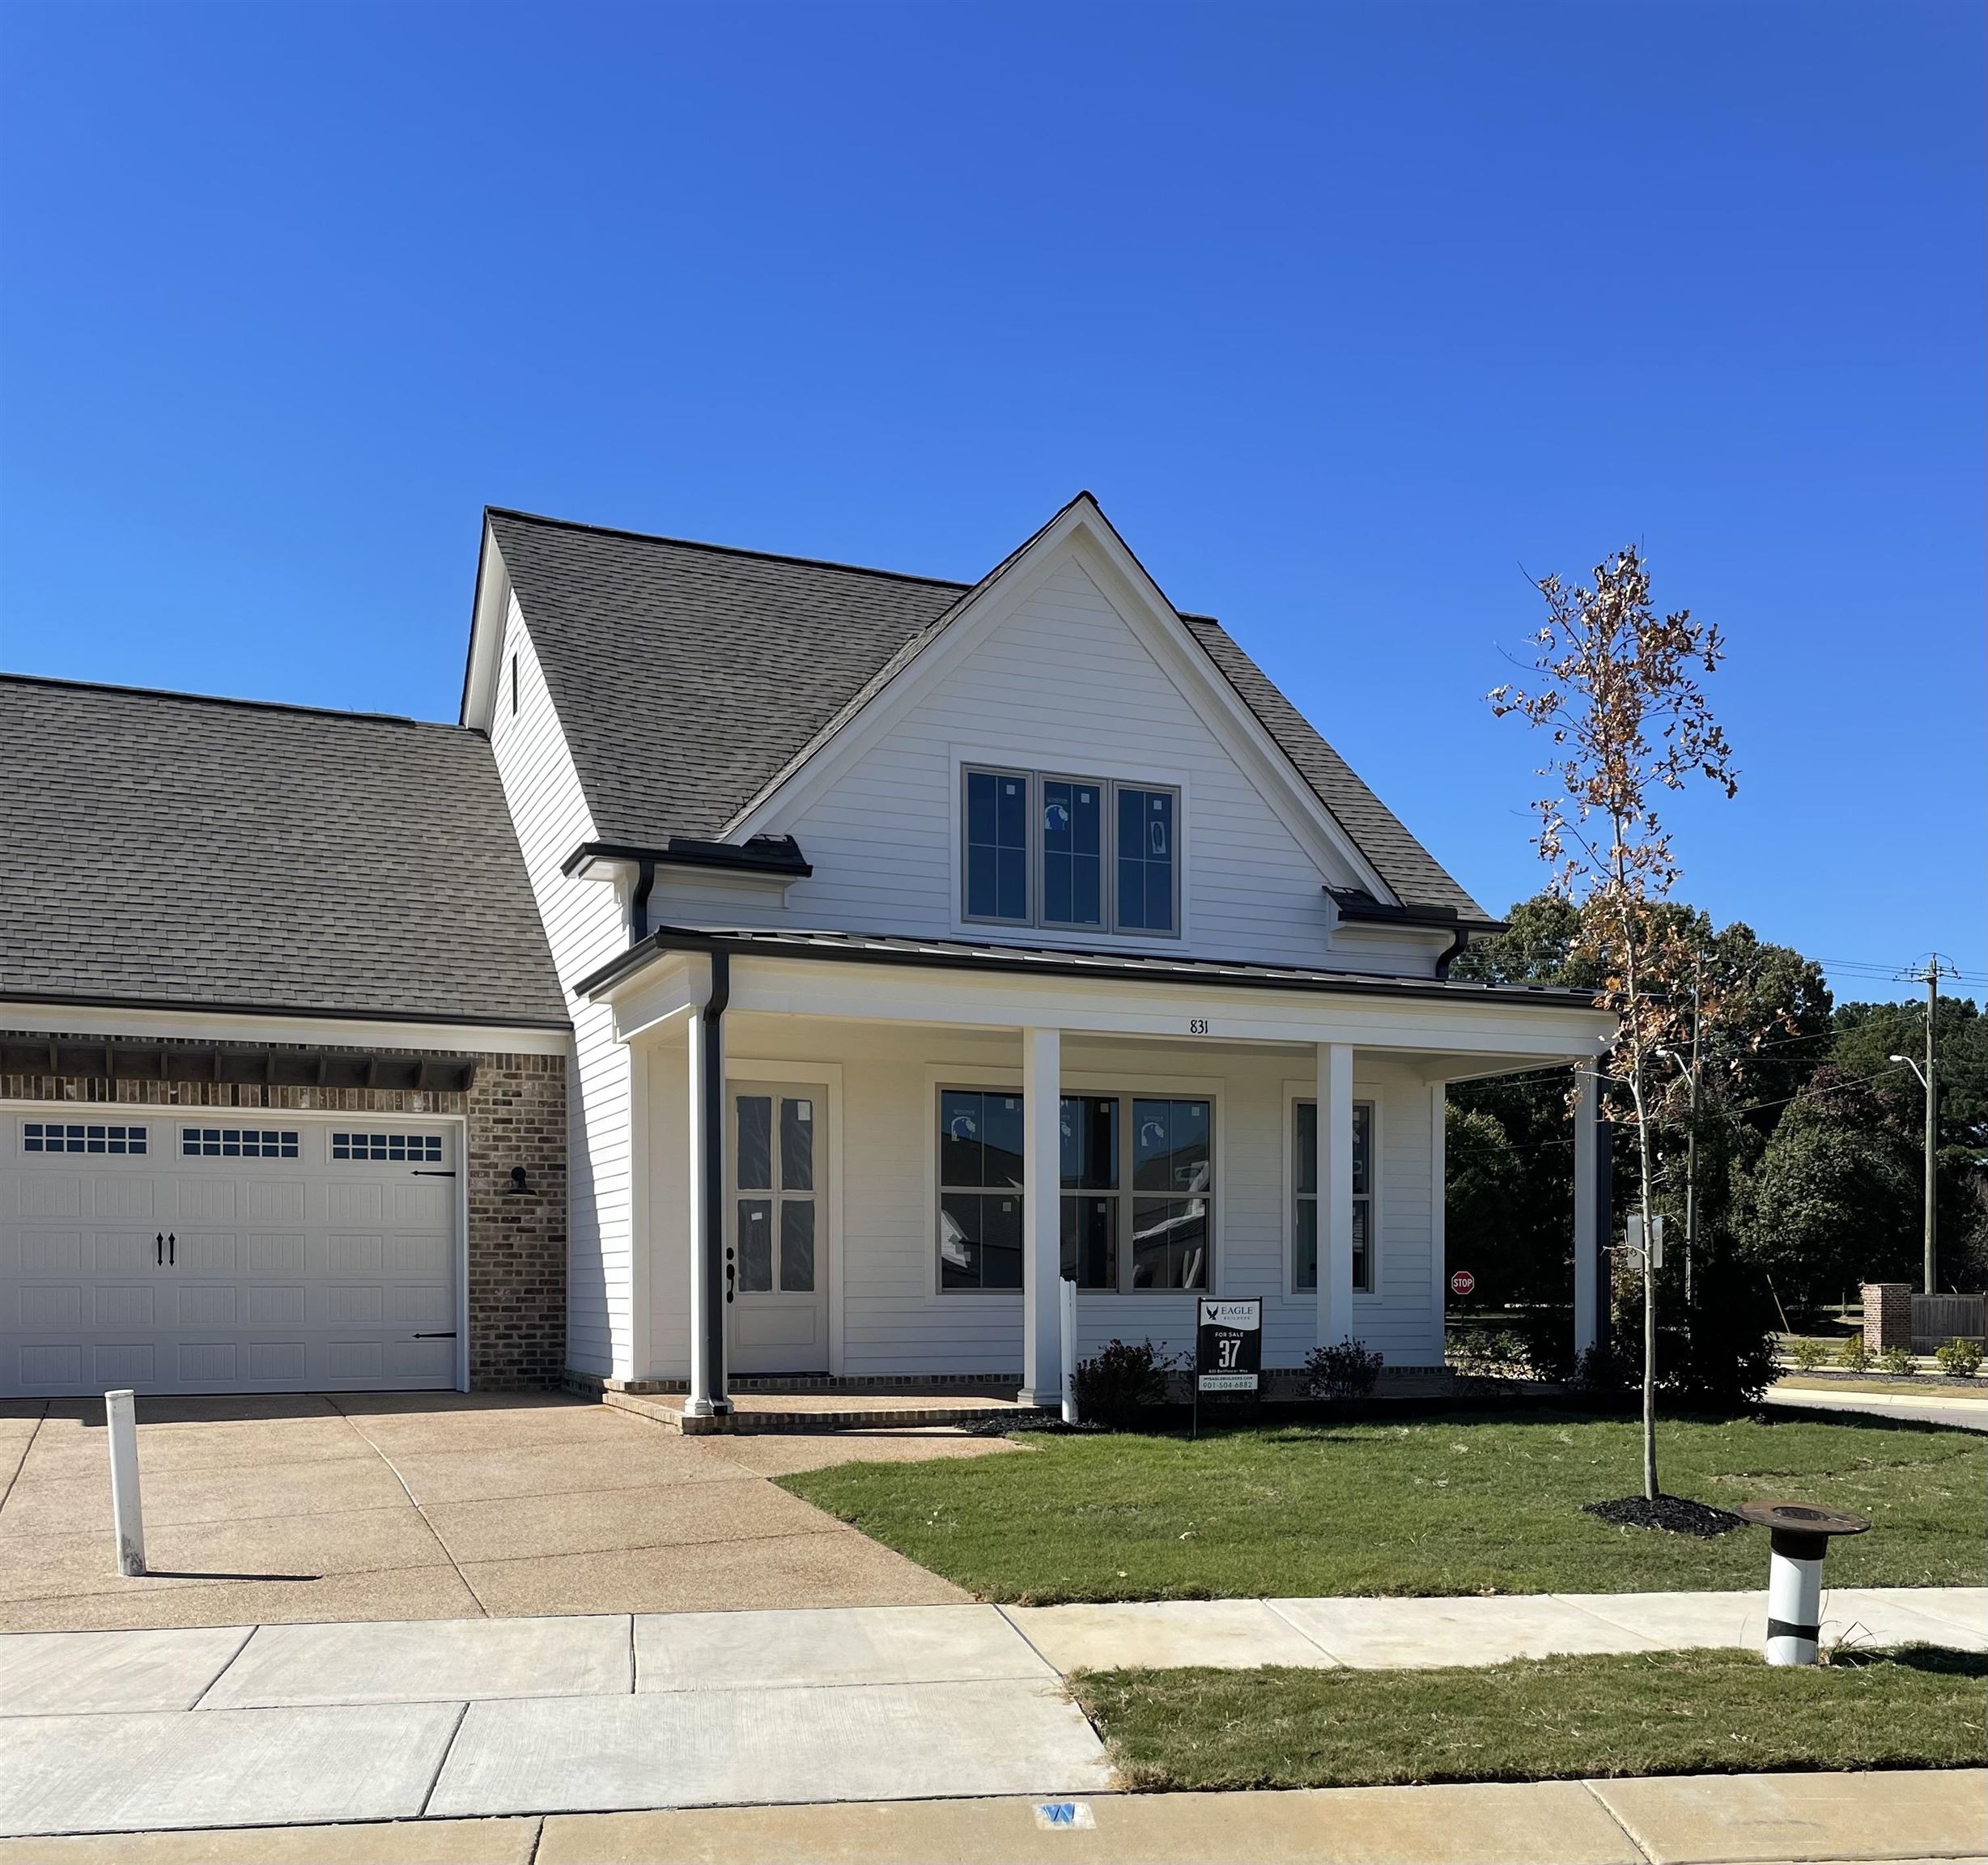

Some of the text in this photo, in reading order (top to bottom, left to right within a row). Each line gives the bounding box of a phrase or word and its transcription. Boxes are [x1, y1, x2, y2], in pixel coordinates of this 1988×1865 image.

[1190, 1019, 1209, 1034] 831
[1453, 1278, 1472, 1288] STOP
[1221, 1306, 1254, 1315] EAGLE
[1218, 1340, 1241, 1368] 37
